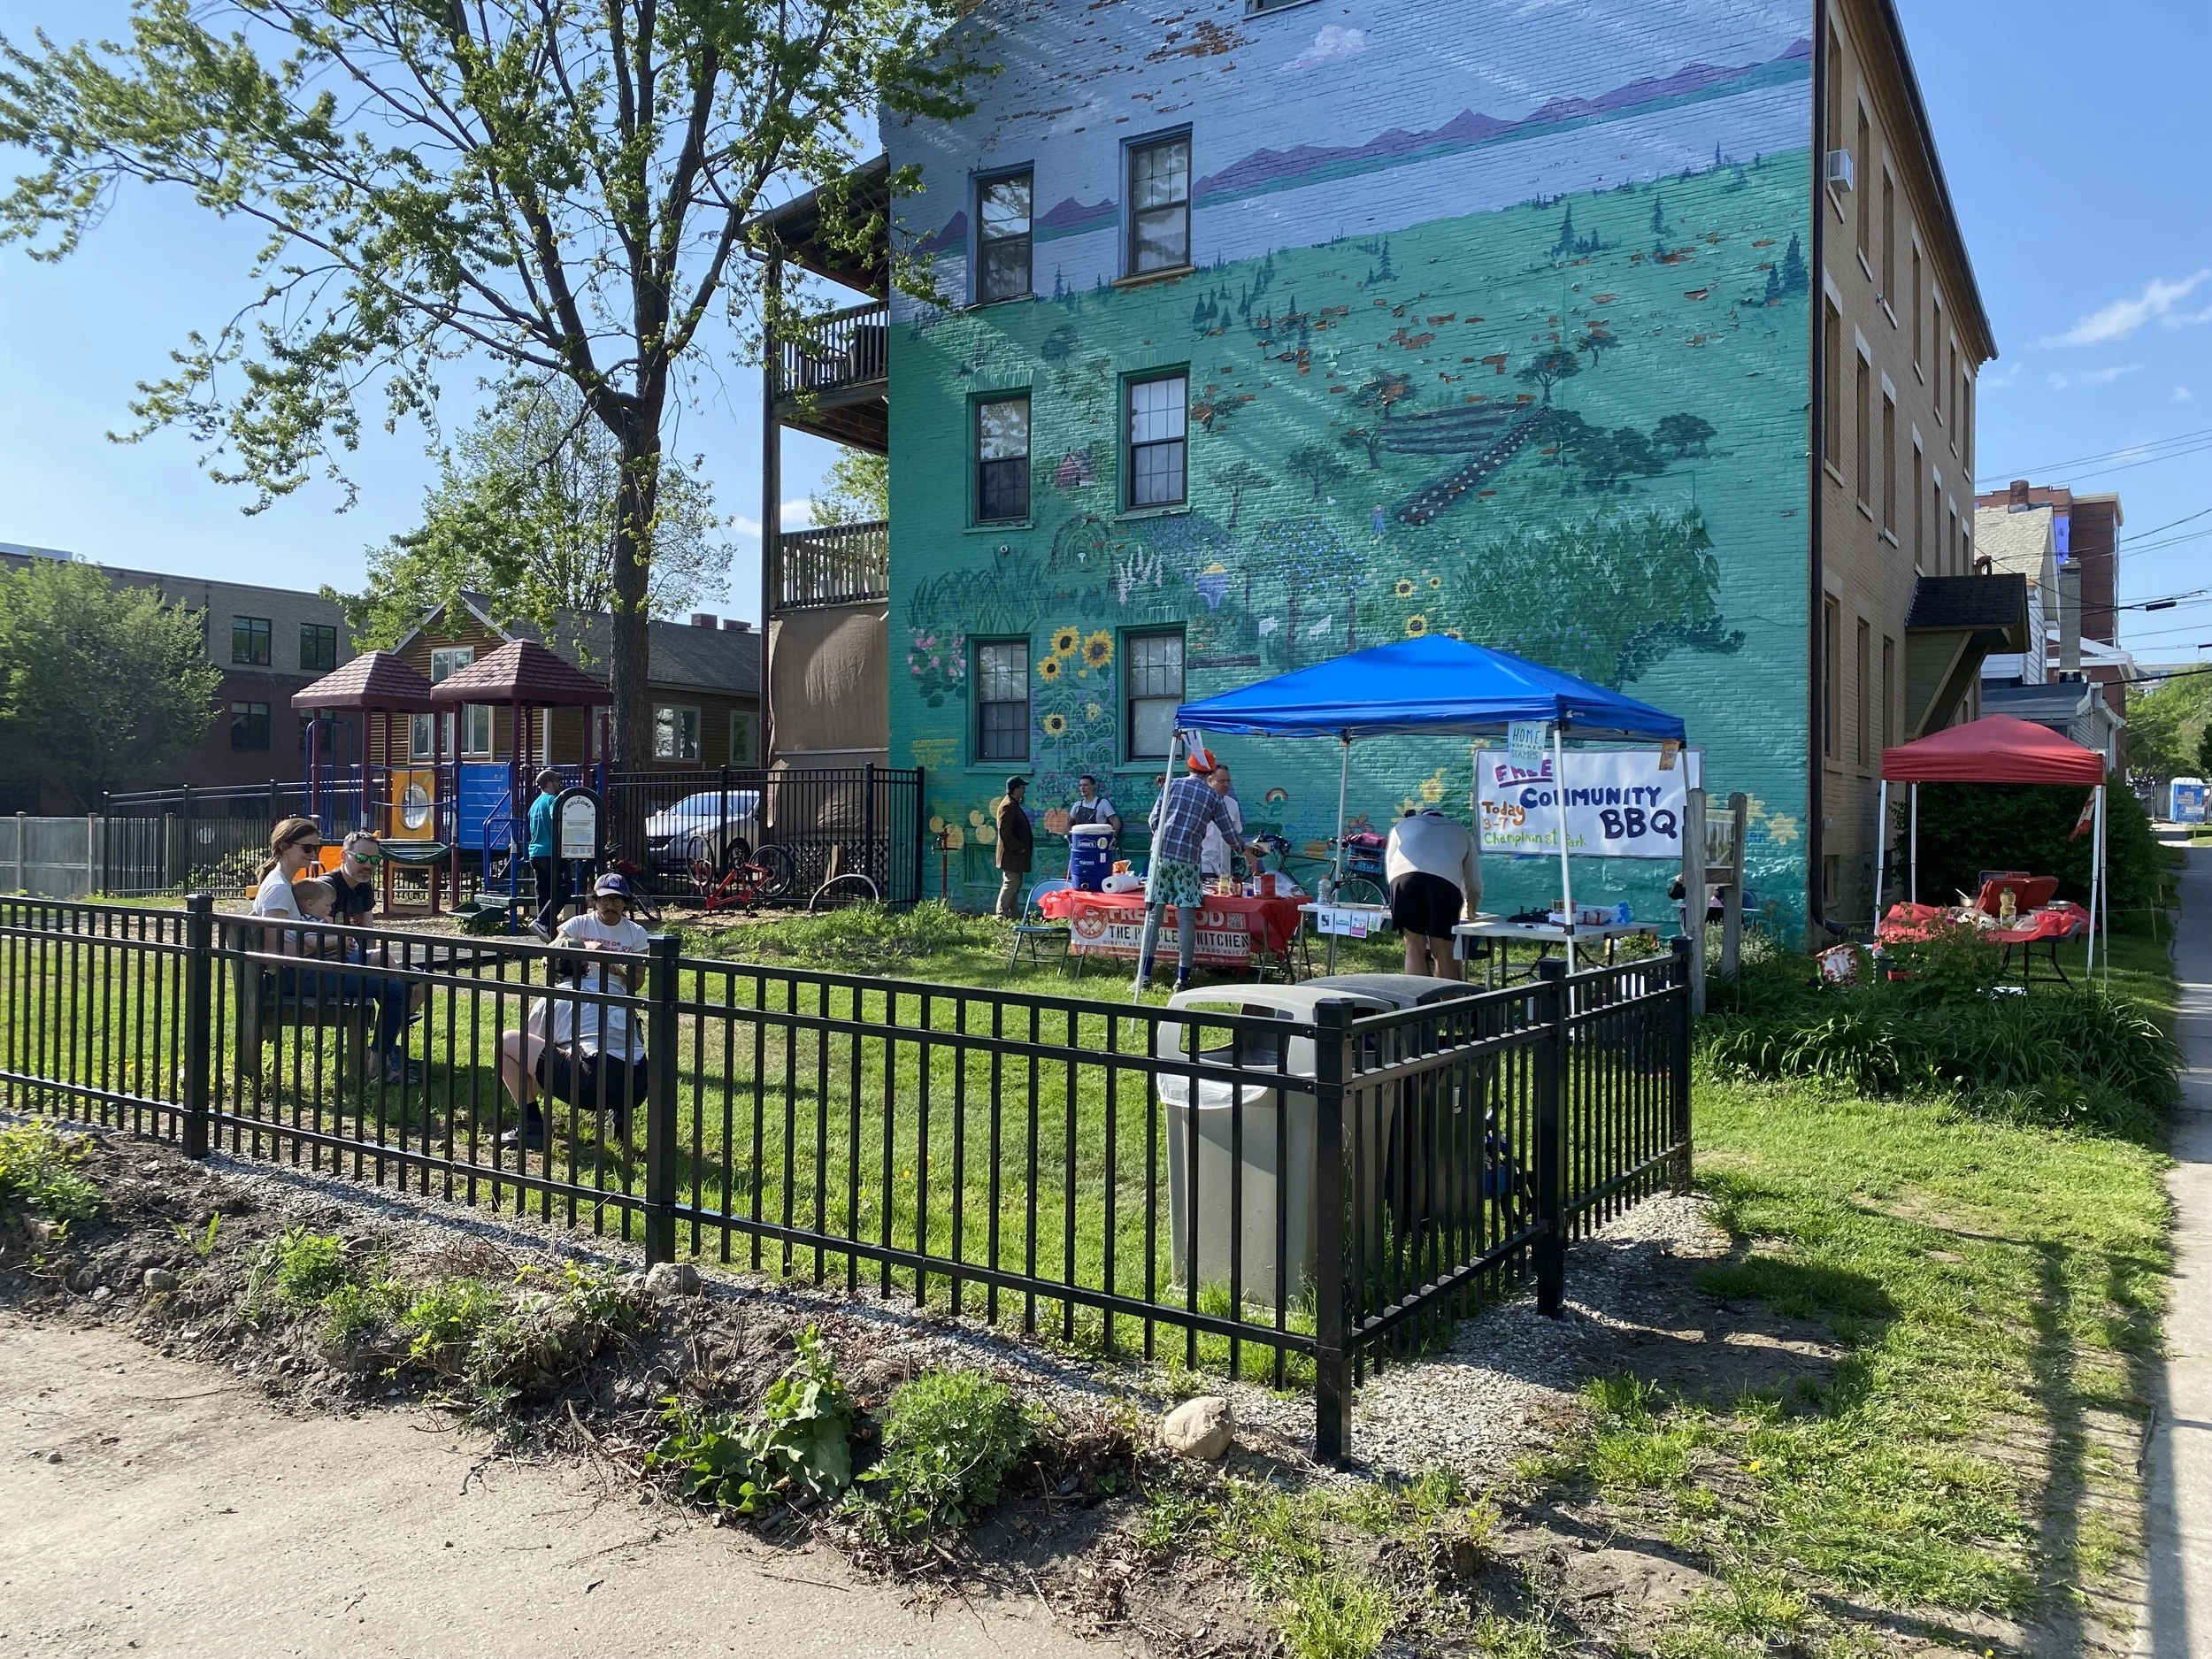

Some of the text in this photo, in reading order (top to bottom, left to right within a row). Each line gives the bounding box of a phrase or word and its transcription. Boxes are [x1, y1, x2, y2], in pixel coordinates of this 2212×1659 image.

[1512, 727, 1541, 744] HOME
[1511, 749, 1539, 760] STAMPS
[566, 800, 592, 809] WELCOME
[1519, 786, 1662, 809] COMMUNITY
[1482, 801, 1525, 826] Today
[1483, 817, 1509, 831] 3-7
[1599, 808, 1678, 839] BBQ
[1484, 832, 1542, 848] Champlain
[1109, 908, 1225, 927] FRE FOD
[1109, 926, 1131, 940] THE
[1197, 933, 1249, 948] KITCHEN
